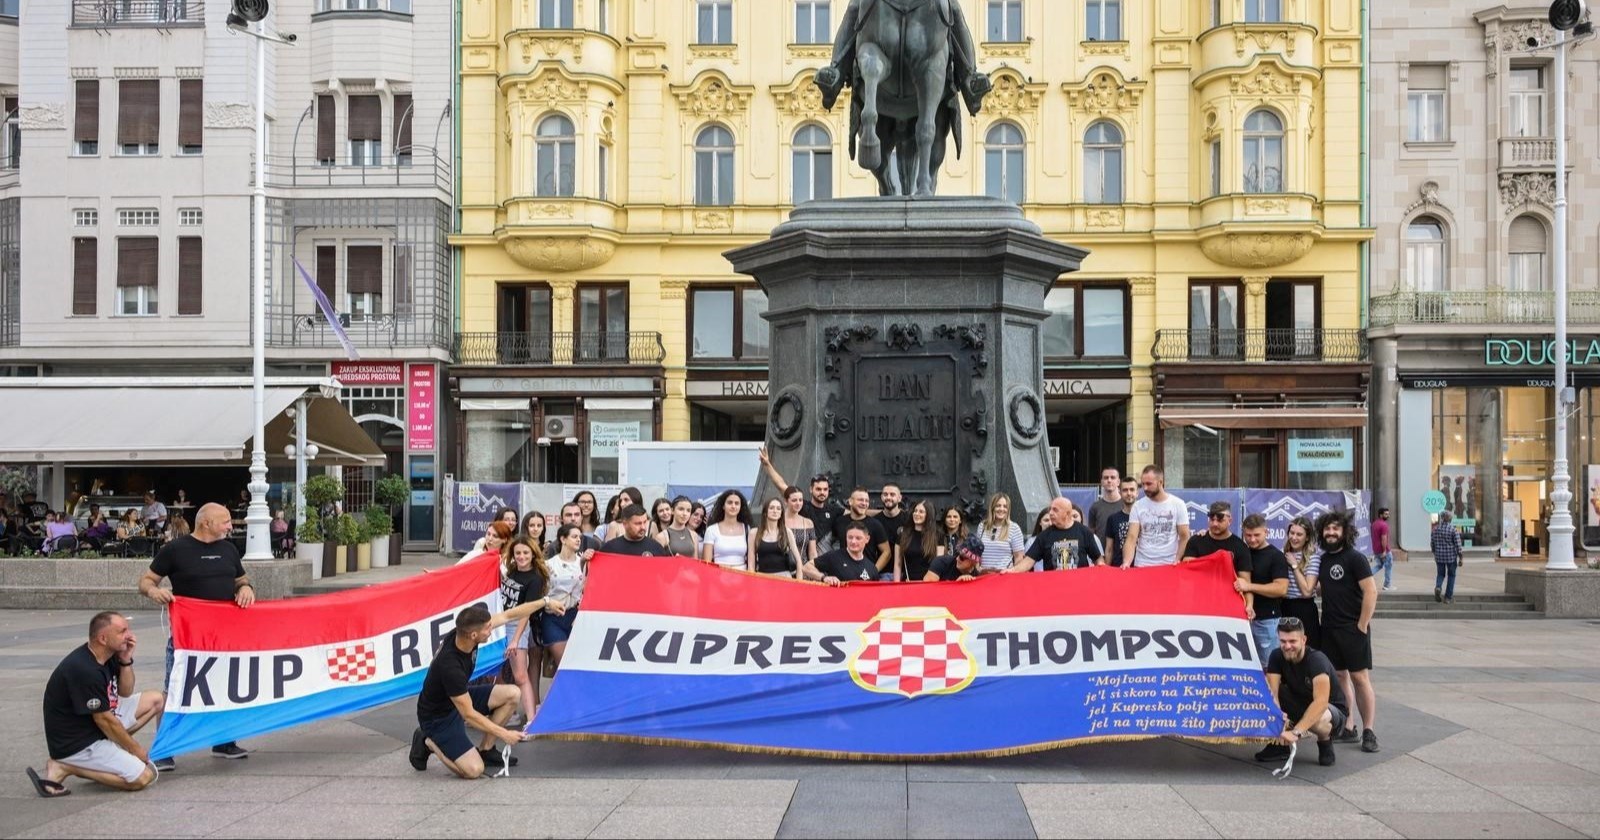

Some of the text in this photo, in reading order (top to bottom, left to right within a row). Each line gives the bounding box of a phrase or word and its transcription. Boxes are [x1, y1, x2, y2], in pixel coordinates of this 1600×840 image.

[341, 373, 400, 381] UREDSKOG PROSTORA
[1414, 380, 1447, 388] DOUGLAS
[879, 373, 932, 401] BAN
[461, 520, 477, 531] AGRAD
[598, 627, 847, 670] KUPRES
[976, 628, 1254, 670] THOMPSON
[181, 653, 303, 707] KUP
[1161, 671, 1206, 685] pobrati
[1209, 673, 1227, 681] me
[1232, 673, 1257, 684] mio,
[1110, 689, 1120, 699] si
[1123, 688, 1157, 698] skoro
[1161, 689, 1178, 697] na
[1087, 700, 1271, 720] jel Kupresko polje uzorano,
[1089, 717, 1109, 734] jel
[1113, 719, 1131, 728] na
[1136, 717, 1177, 732] njemu
[1181, 716, 1206, 729] žito
